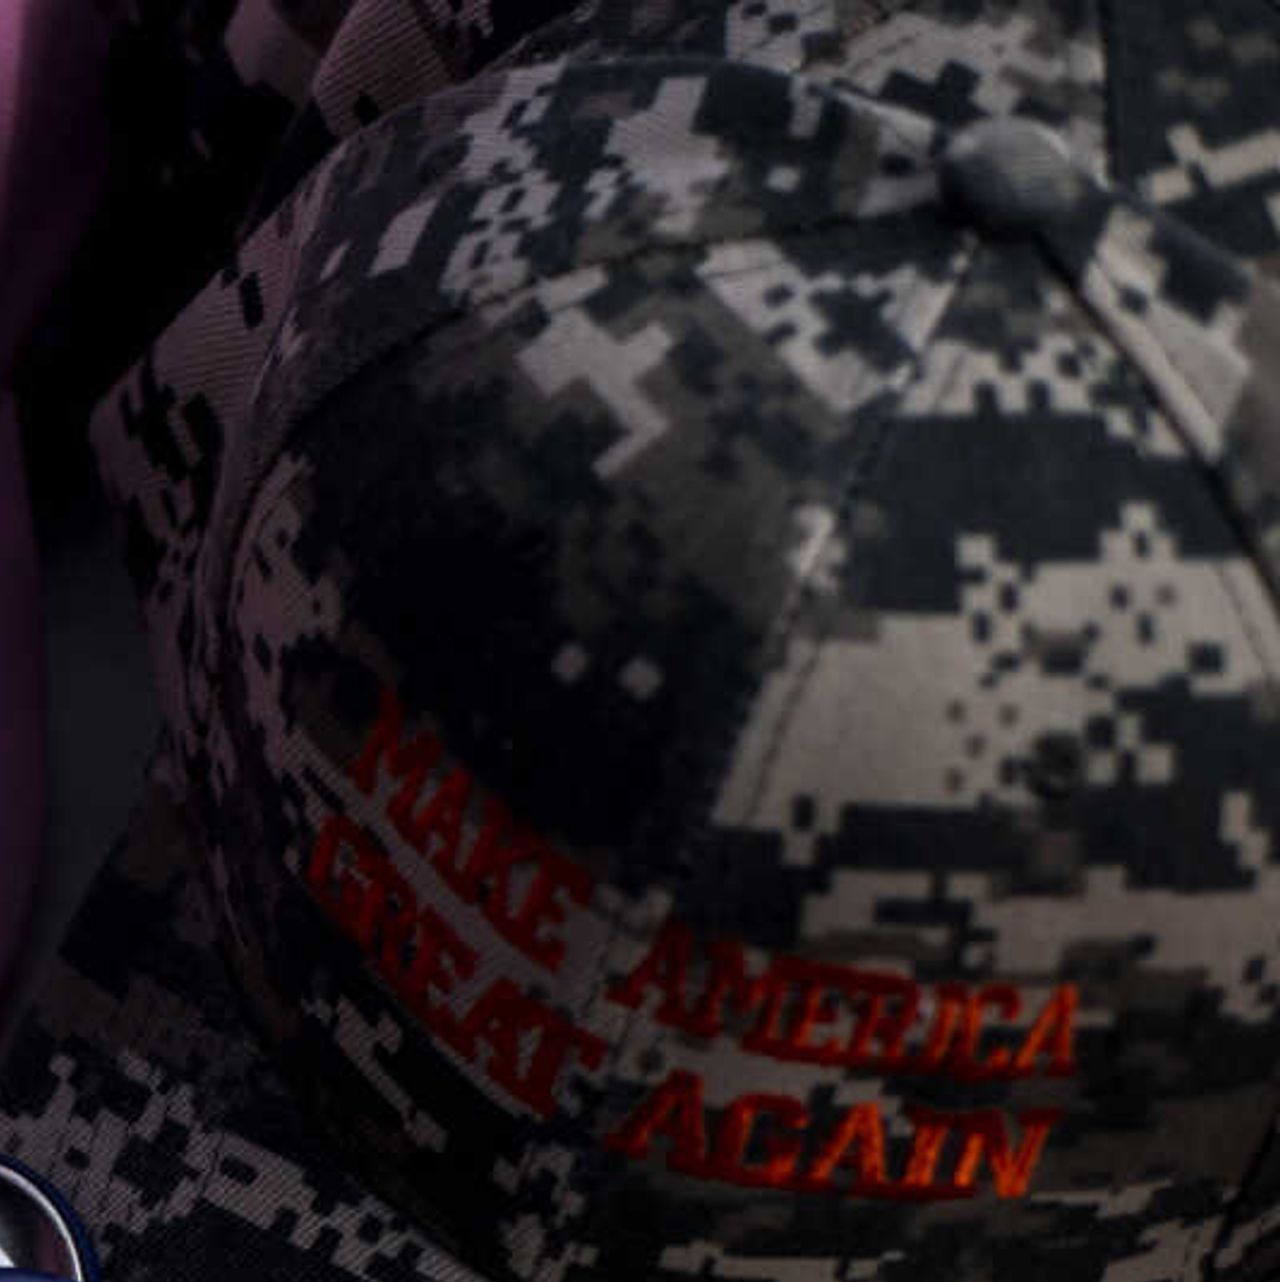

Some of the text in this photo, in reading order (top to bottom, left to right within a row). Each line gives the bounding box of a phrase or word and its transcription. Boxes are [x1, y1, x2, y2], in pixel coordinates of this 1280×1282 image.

[304, 815, 1064, 1200] GREAT AGAIN
[345, 682, 1081, 1083] MAKE AMERICA
